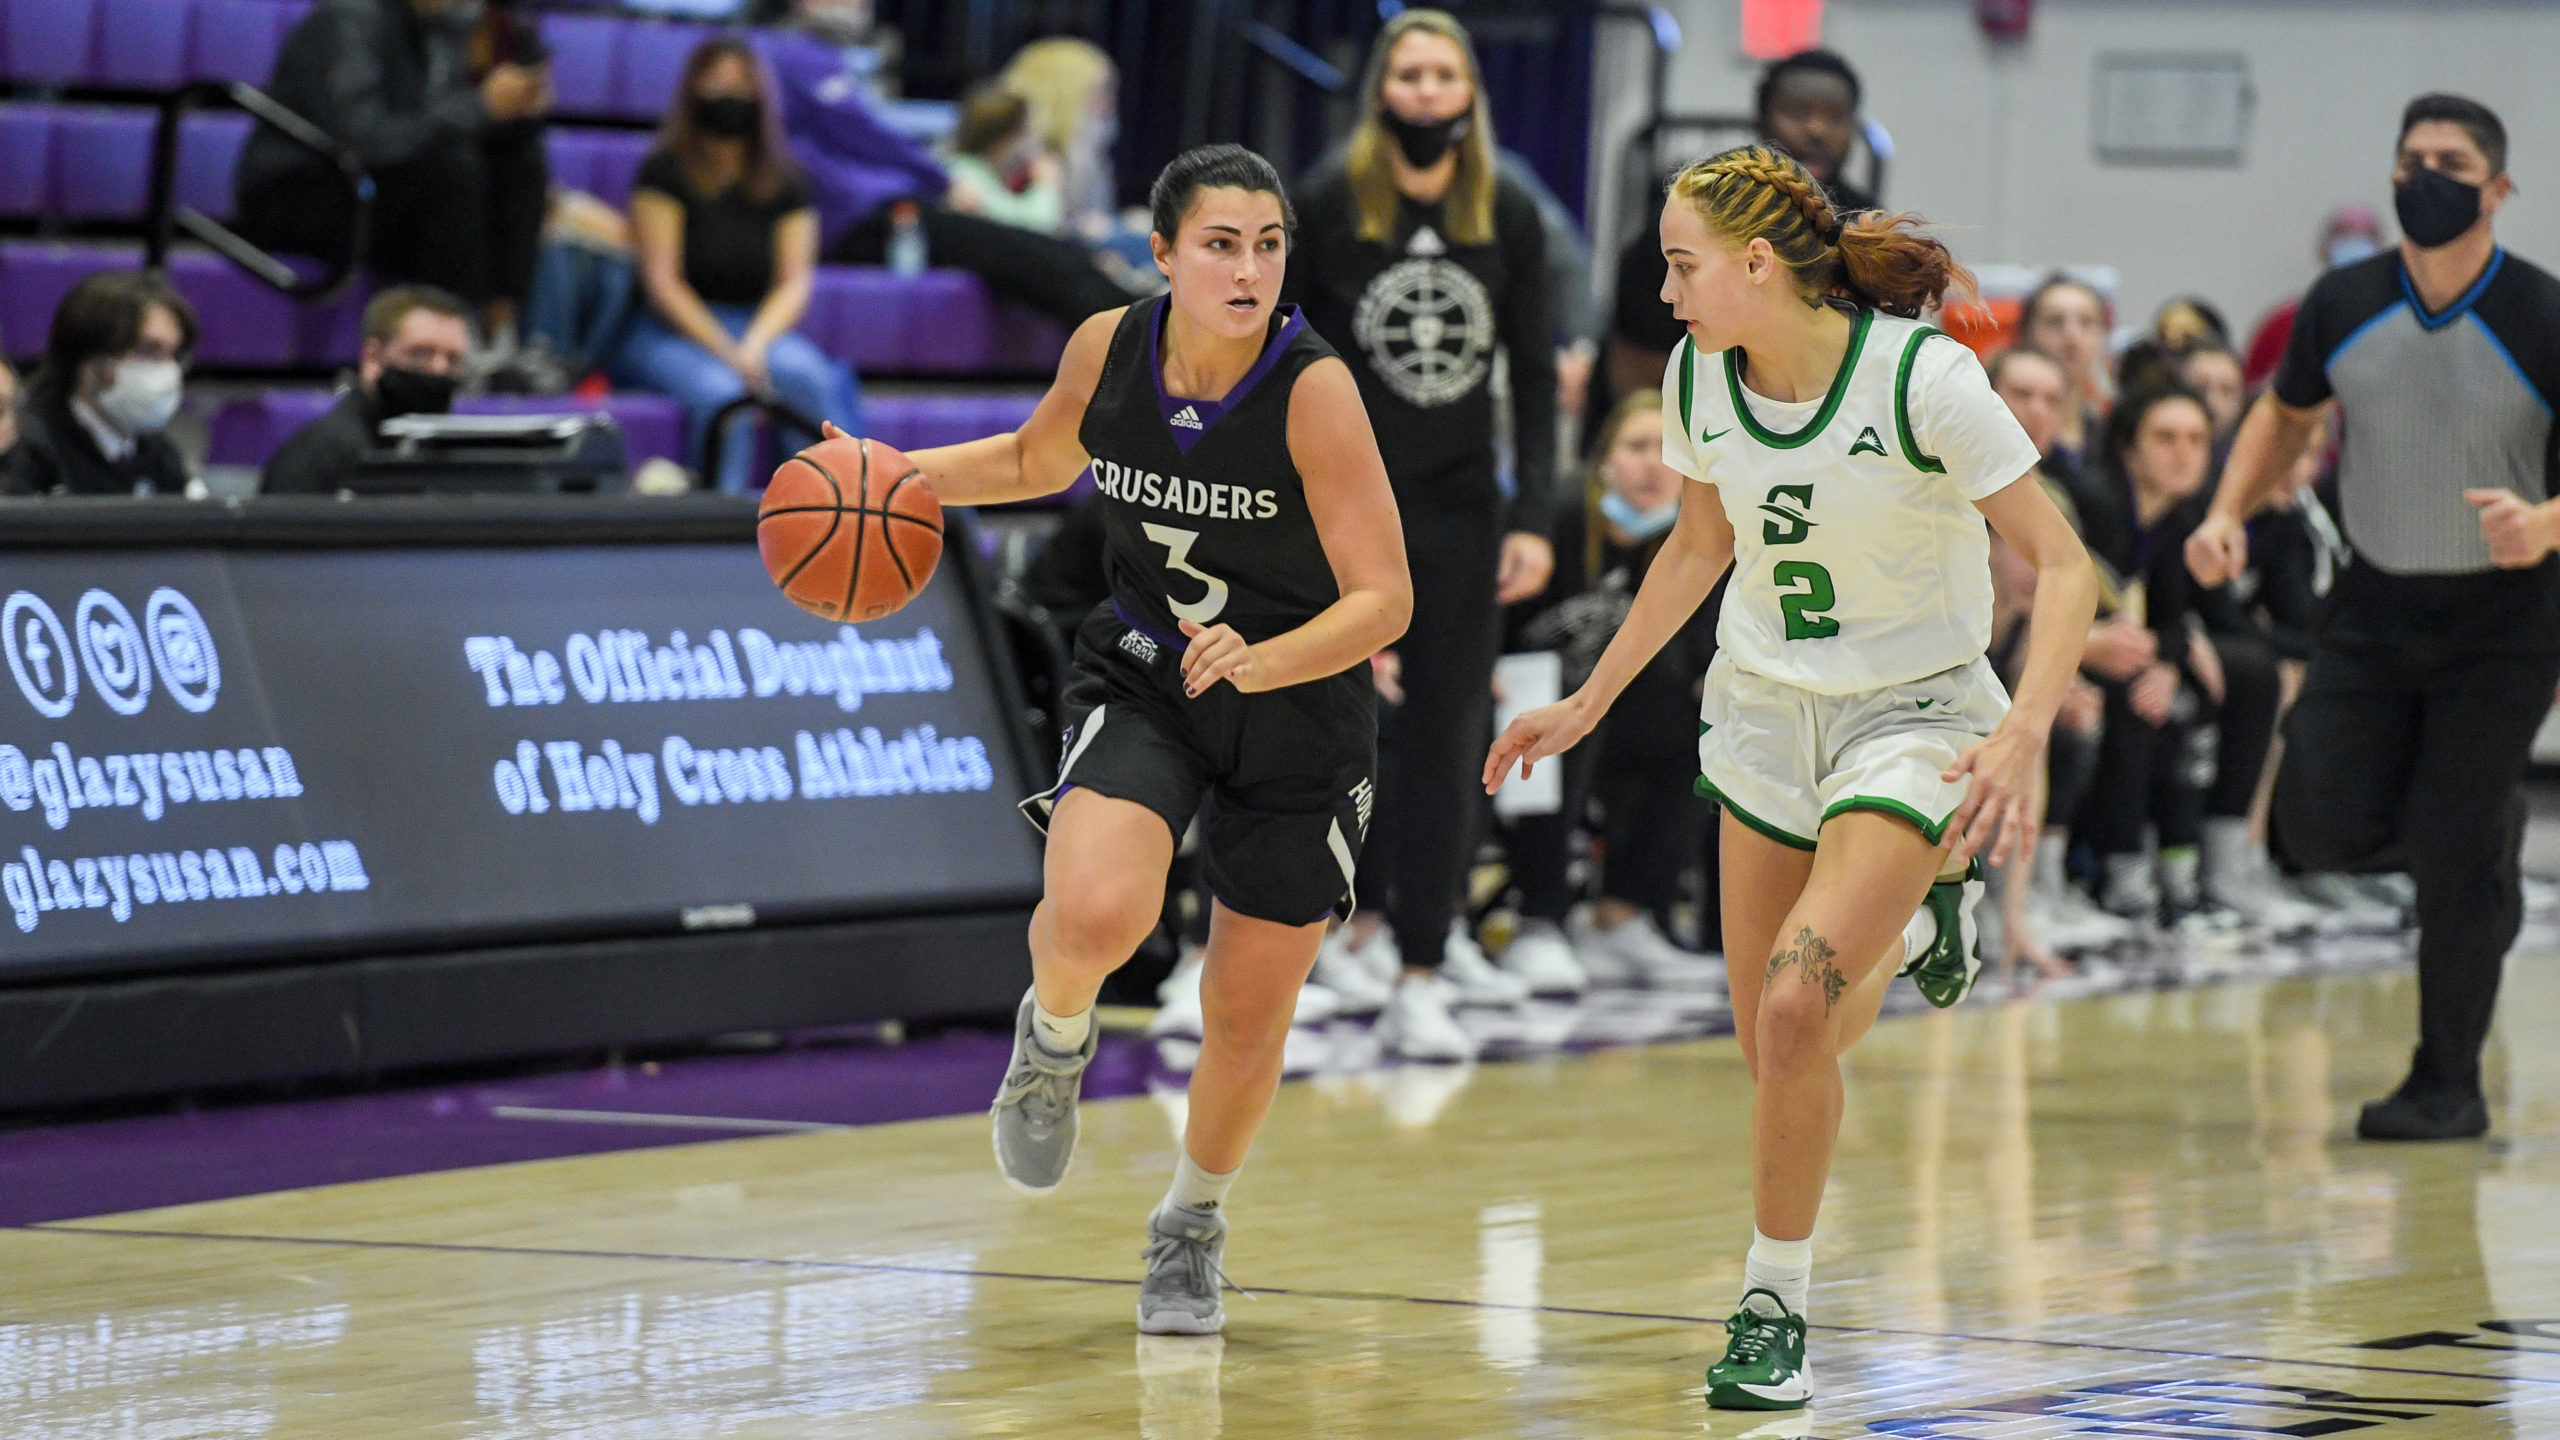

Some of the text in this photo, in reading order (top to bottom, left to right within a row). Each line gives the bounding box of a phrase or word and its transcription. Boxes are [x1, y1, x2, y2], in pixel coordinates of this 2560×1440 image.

[1170, 417, 1204, 430] adidas
[1091, 457, 1278, 520] CRUSADERS
[1141, 521, 1229, 624] 3
[1773, 560, 1840, 641] 2
[465, 624, 953, 712] The Official Doughnut
[0, 741, 303, 830] @glazysusan
[494, 724, 993, 825] of Holy Cross Athletics
[2, 840, 370, 933] glazysusan.com
